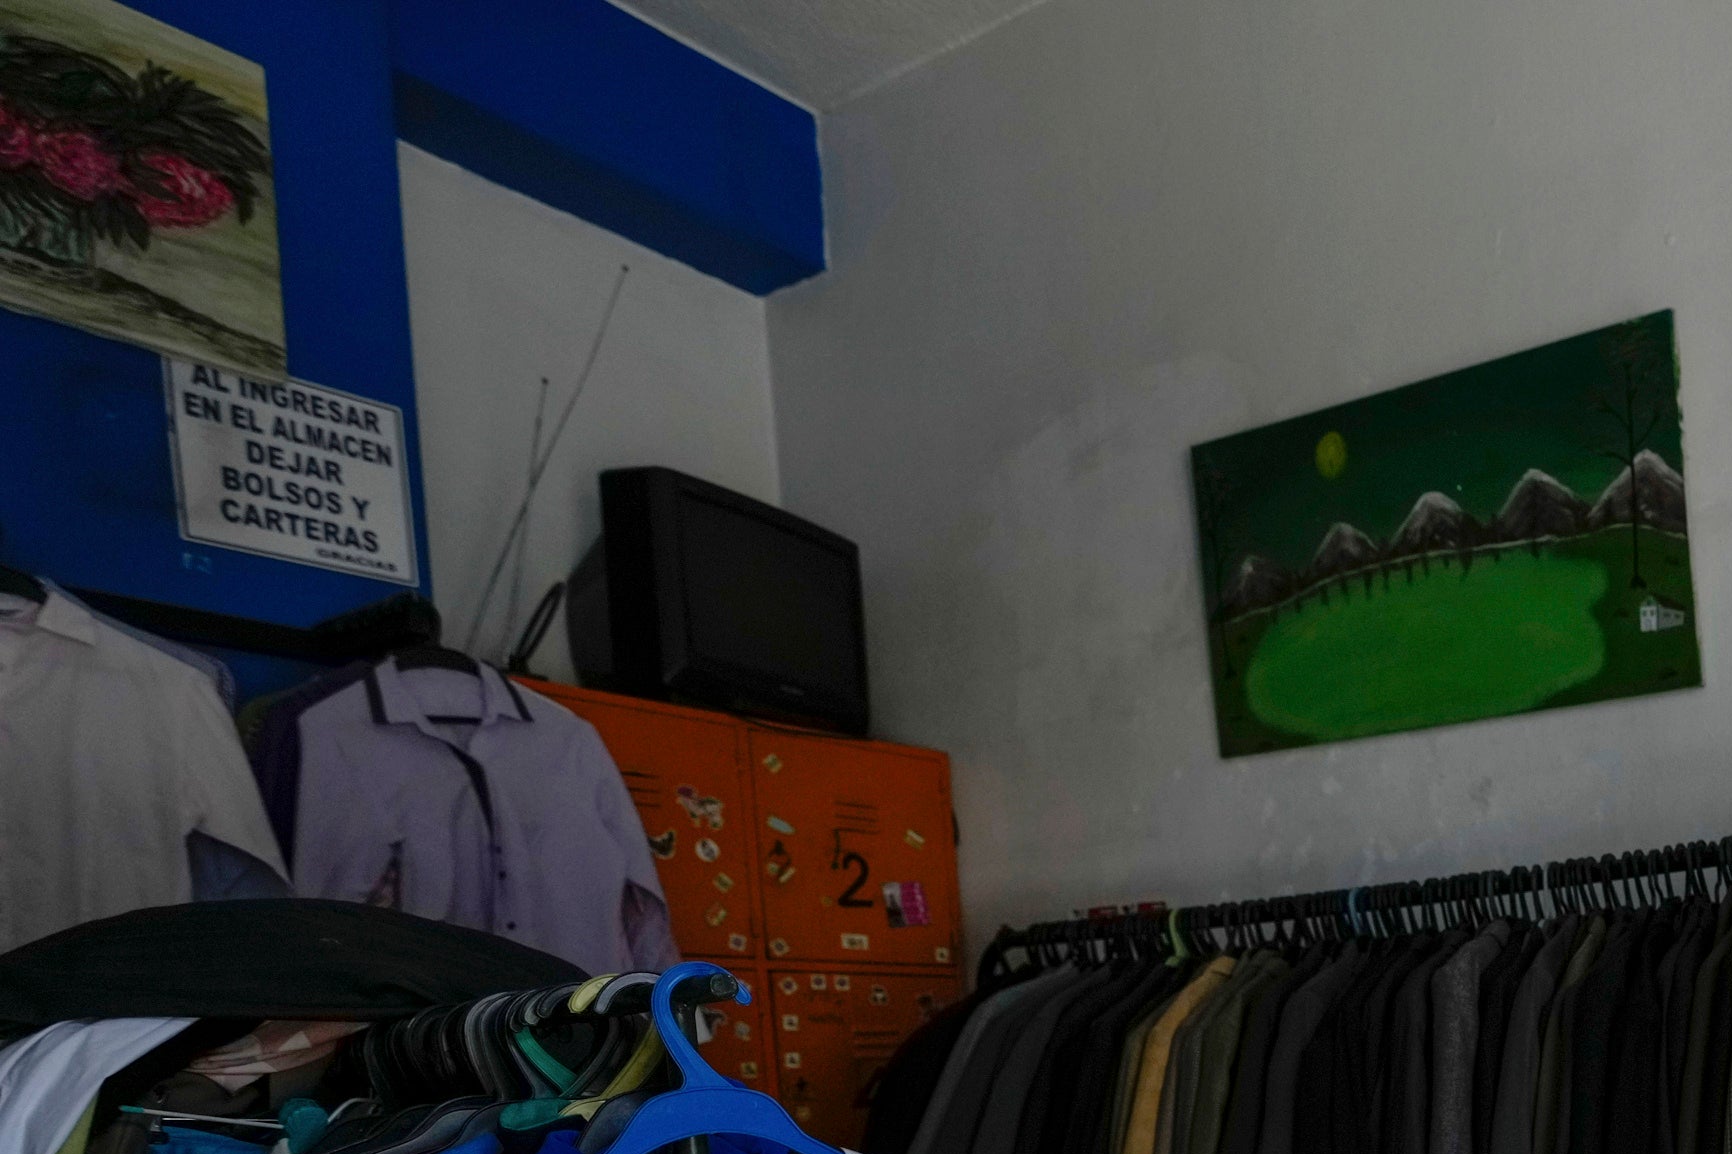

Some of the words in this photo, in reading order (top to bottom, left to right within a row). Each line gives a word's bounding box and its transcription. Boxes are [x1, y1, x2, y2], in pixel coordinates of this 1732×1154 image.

[193, 365, 229, 393] AL
[239, 378, 381, 434] INGRESAR
[184, 392, 221, 422] EN
[230, 405, 263, 433] EL
[272, 416, 392, 467] ALMACEN
[246, 440, 343, 485] DEJAR
[222, 466, 342, 514] BOLSOS
[352, 496, 369, 521] Y
[221, 500, 378, 552] CARTERAS
[838, 852, 873, 908] 2
